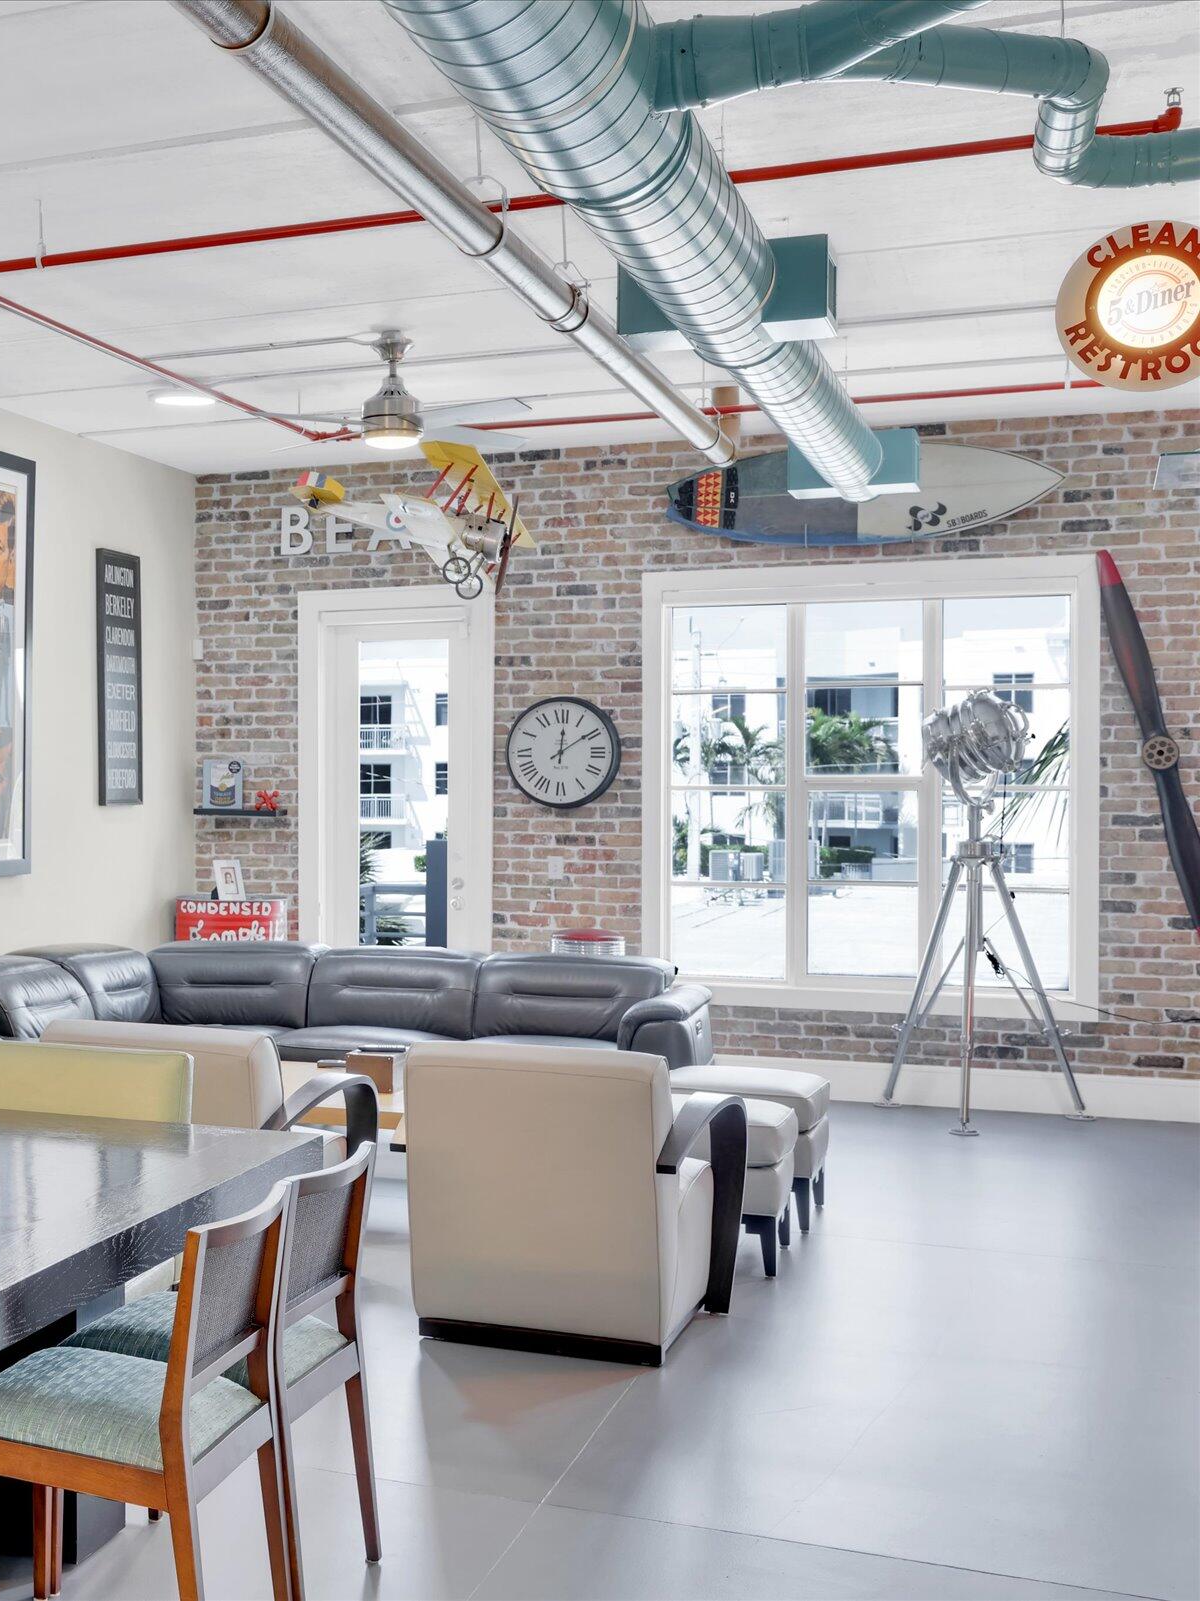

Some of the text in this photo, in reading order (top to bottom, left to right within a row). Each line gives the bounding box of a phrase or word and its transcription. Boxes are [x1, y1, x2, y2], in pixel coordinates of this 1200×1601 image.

[104, 563, 134, 588] ARLINGTON
[105, 593, 135, 619] BERKELEY
[105, 625, 135, 647] CLARENDON
[106, 682, 136, 700] EXETER
[106, 708, 137, 732] FAIRFIELD
[107, 768, 138, 789] HEREFORD
[180, 901, 272, 916] CONDENSED
